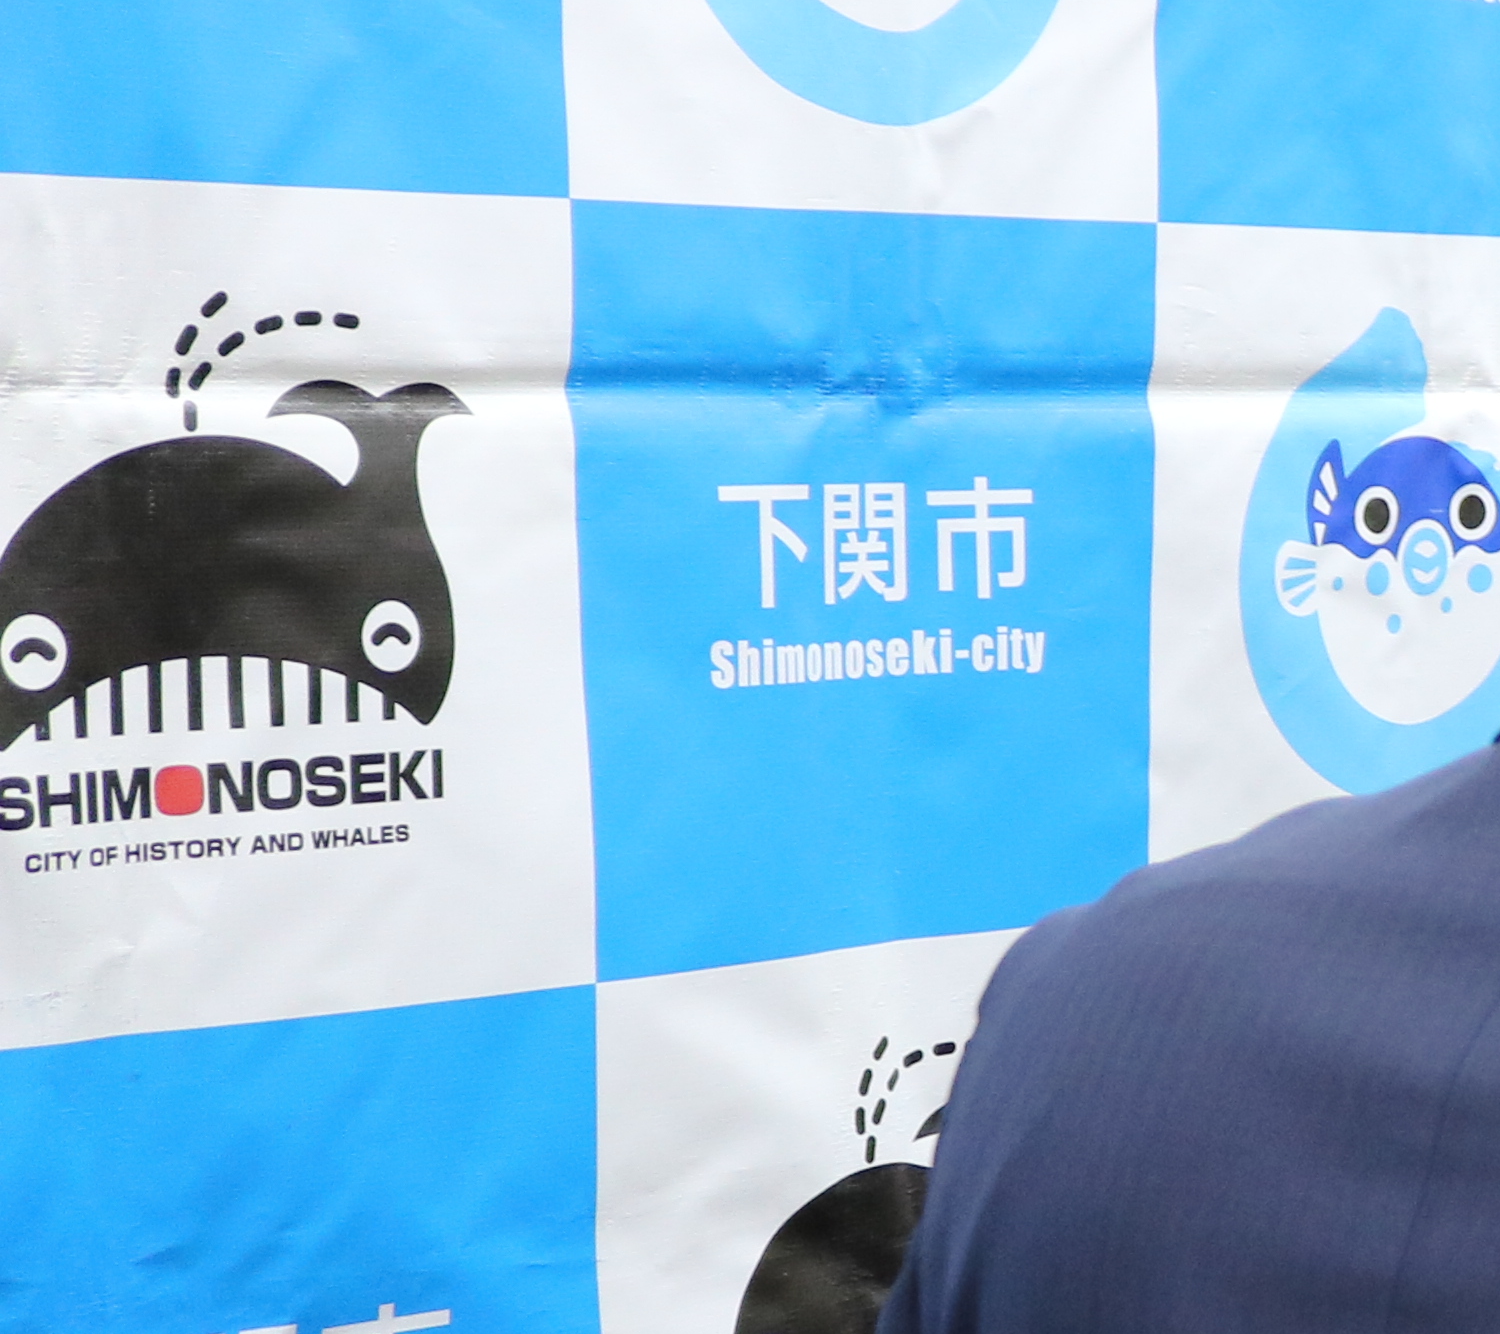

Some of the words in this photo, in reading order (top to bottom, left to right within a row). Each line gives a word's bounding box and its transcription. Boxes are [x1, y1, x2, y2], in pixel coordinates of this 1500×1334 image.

[717, 476, 1034, 609] 下関市
[710, 625, 1046, 689] Shimonoseki-city
[24, 851, 82, 873] CITY
[90, 846, 118, 867] OF
[124, 836, 240, 864] HISTORY
[250, 833, 303, 855] AND
[311, 824, 410, 849] WHALES
